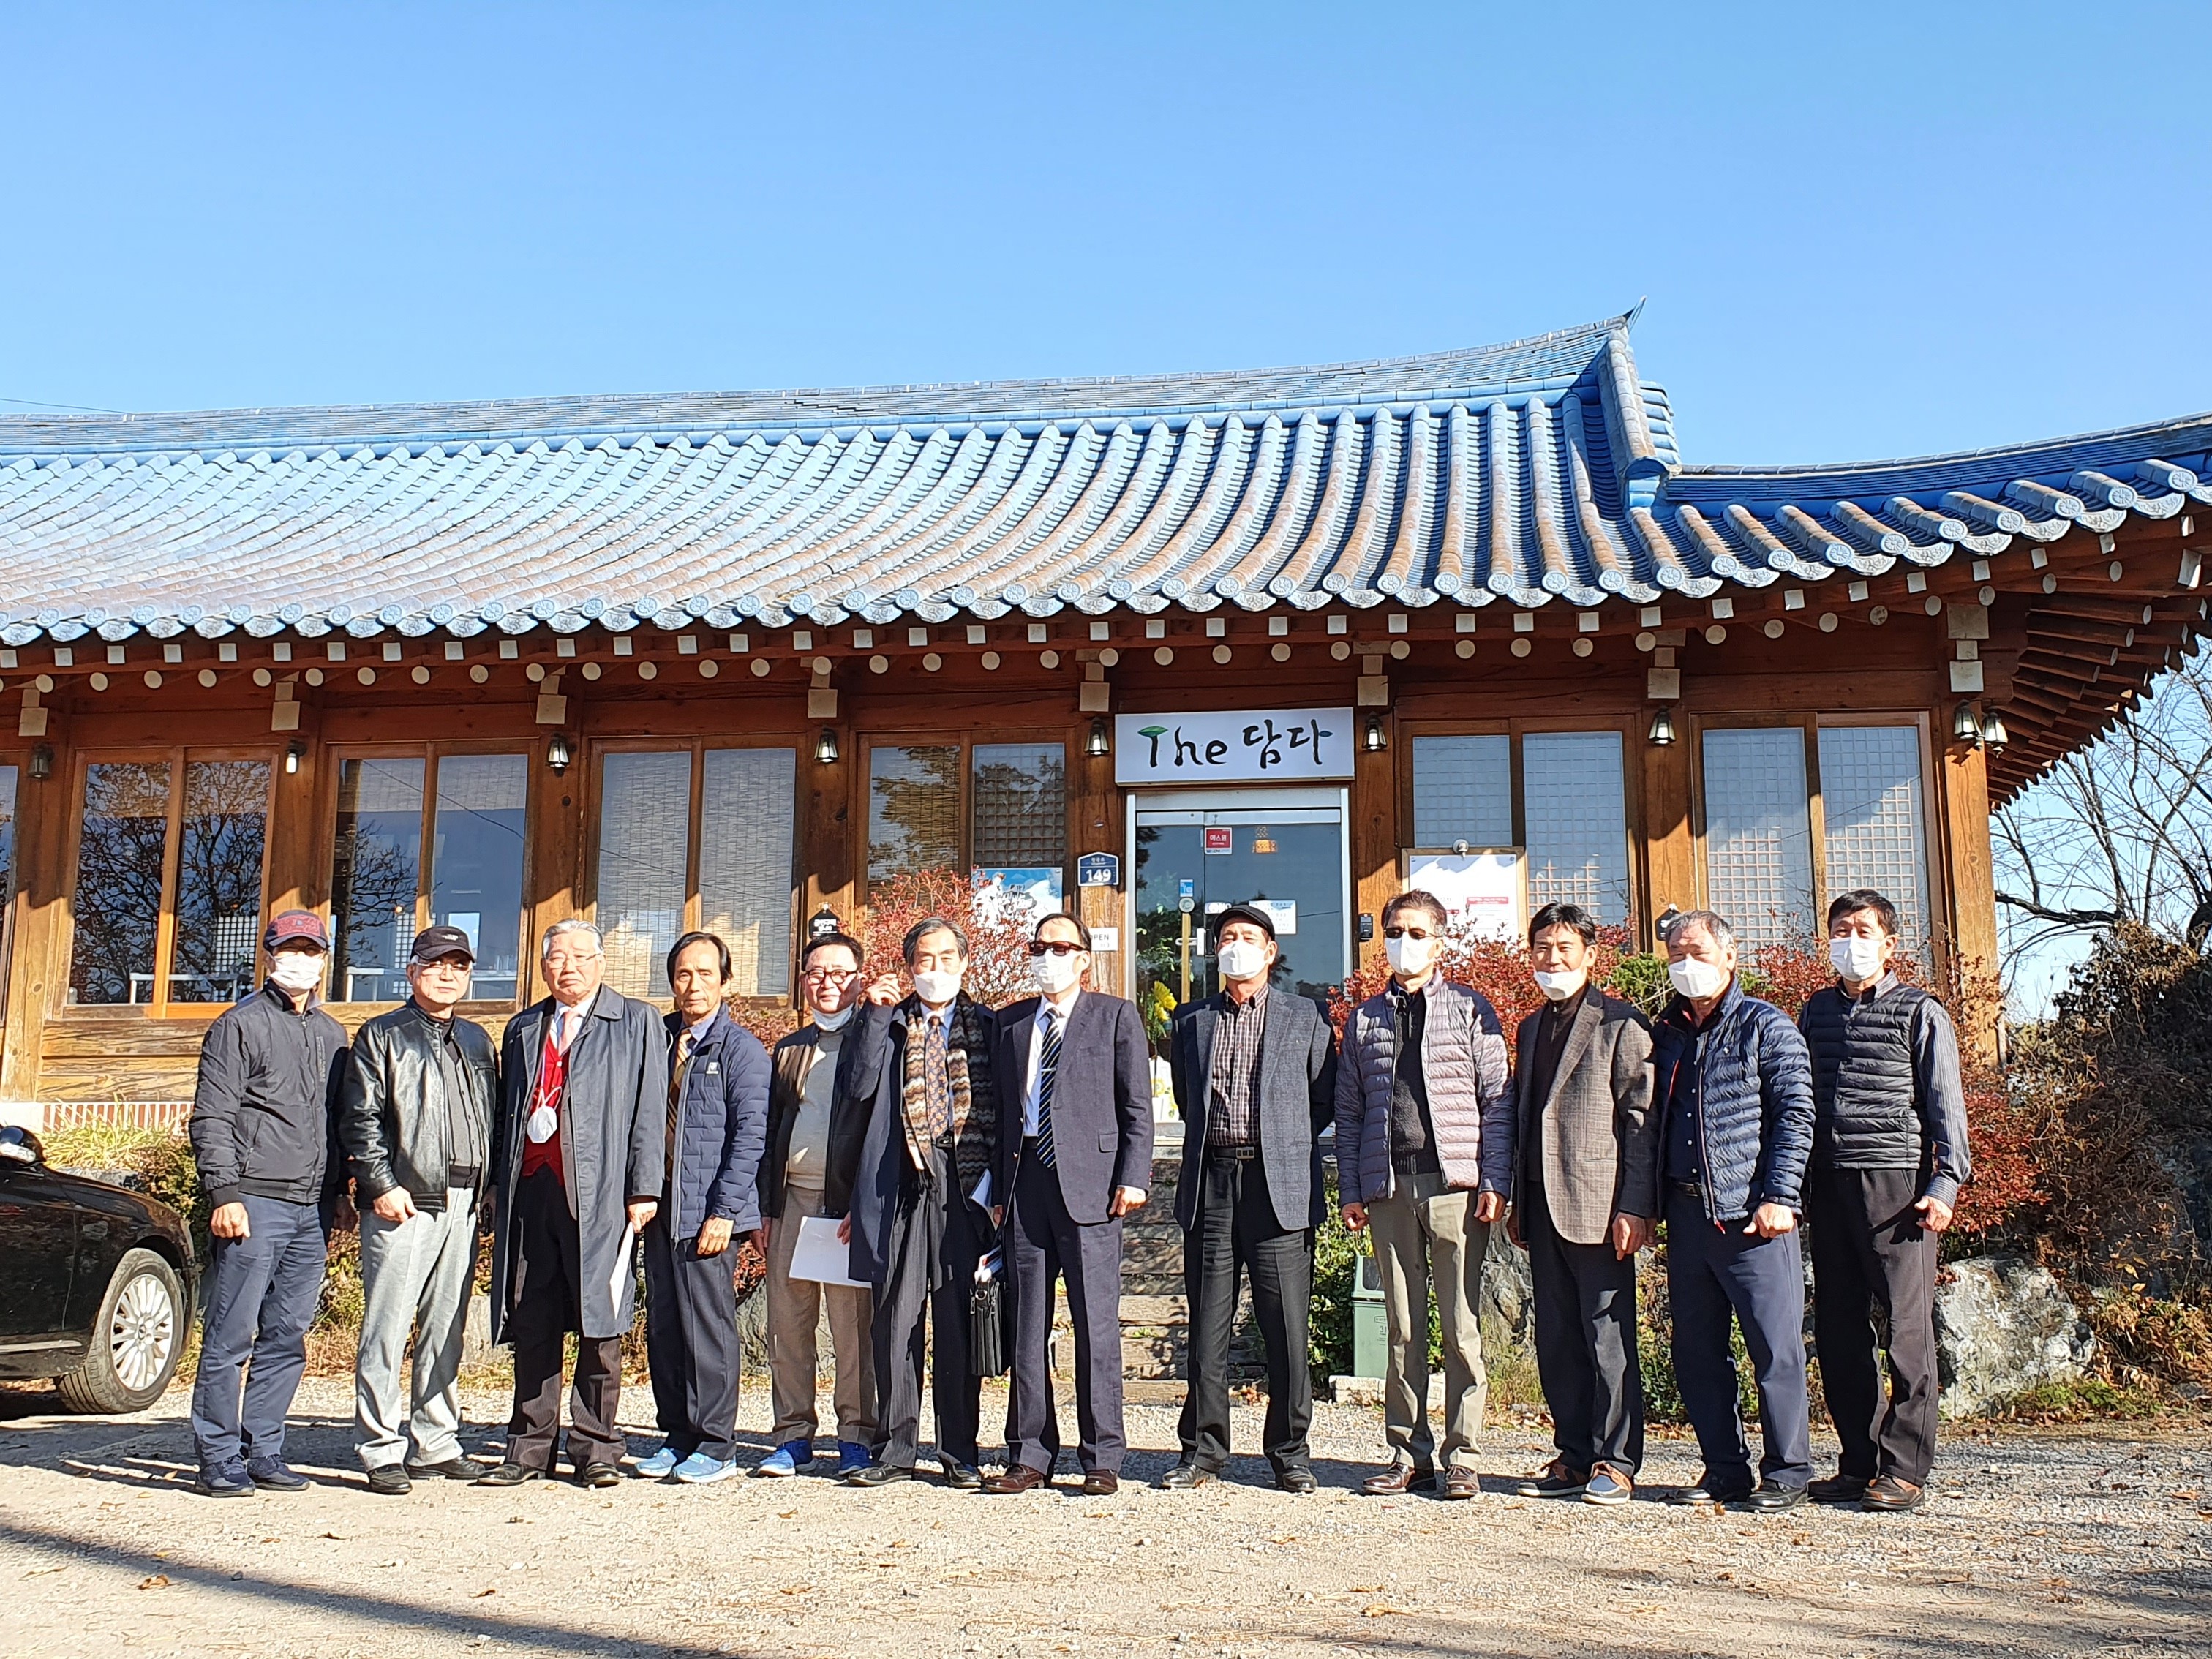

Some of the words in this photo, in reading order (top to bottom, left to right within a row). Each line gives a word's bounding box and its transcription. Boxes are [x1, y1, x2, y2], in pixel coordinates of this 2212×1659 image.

[1137, 726, 1227, 767] The
[1242, 719, 1333, 769] 담다
[1086, 868, 1111, 882] 149
